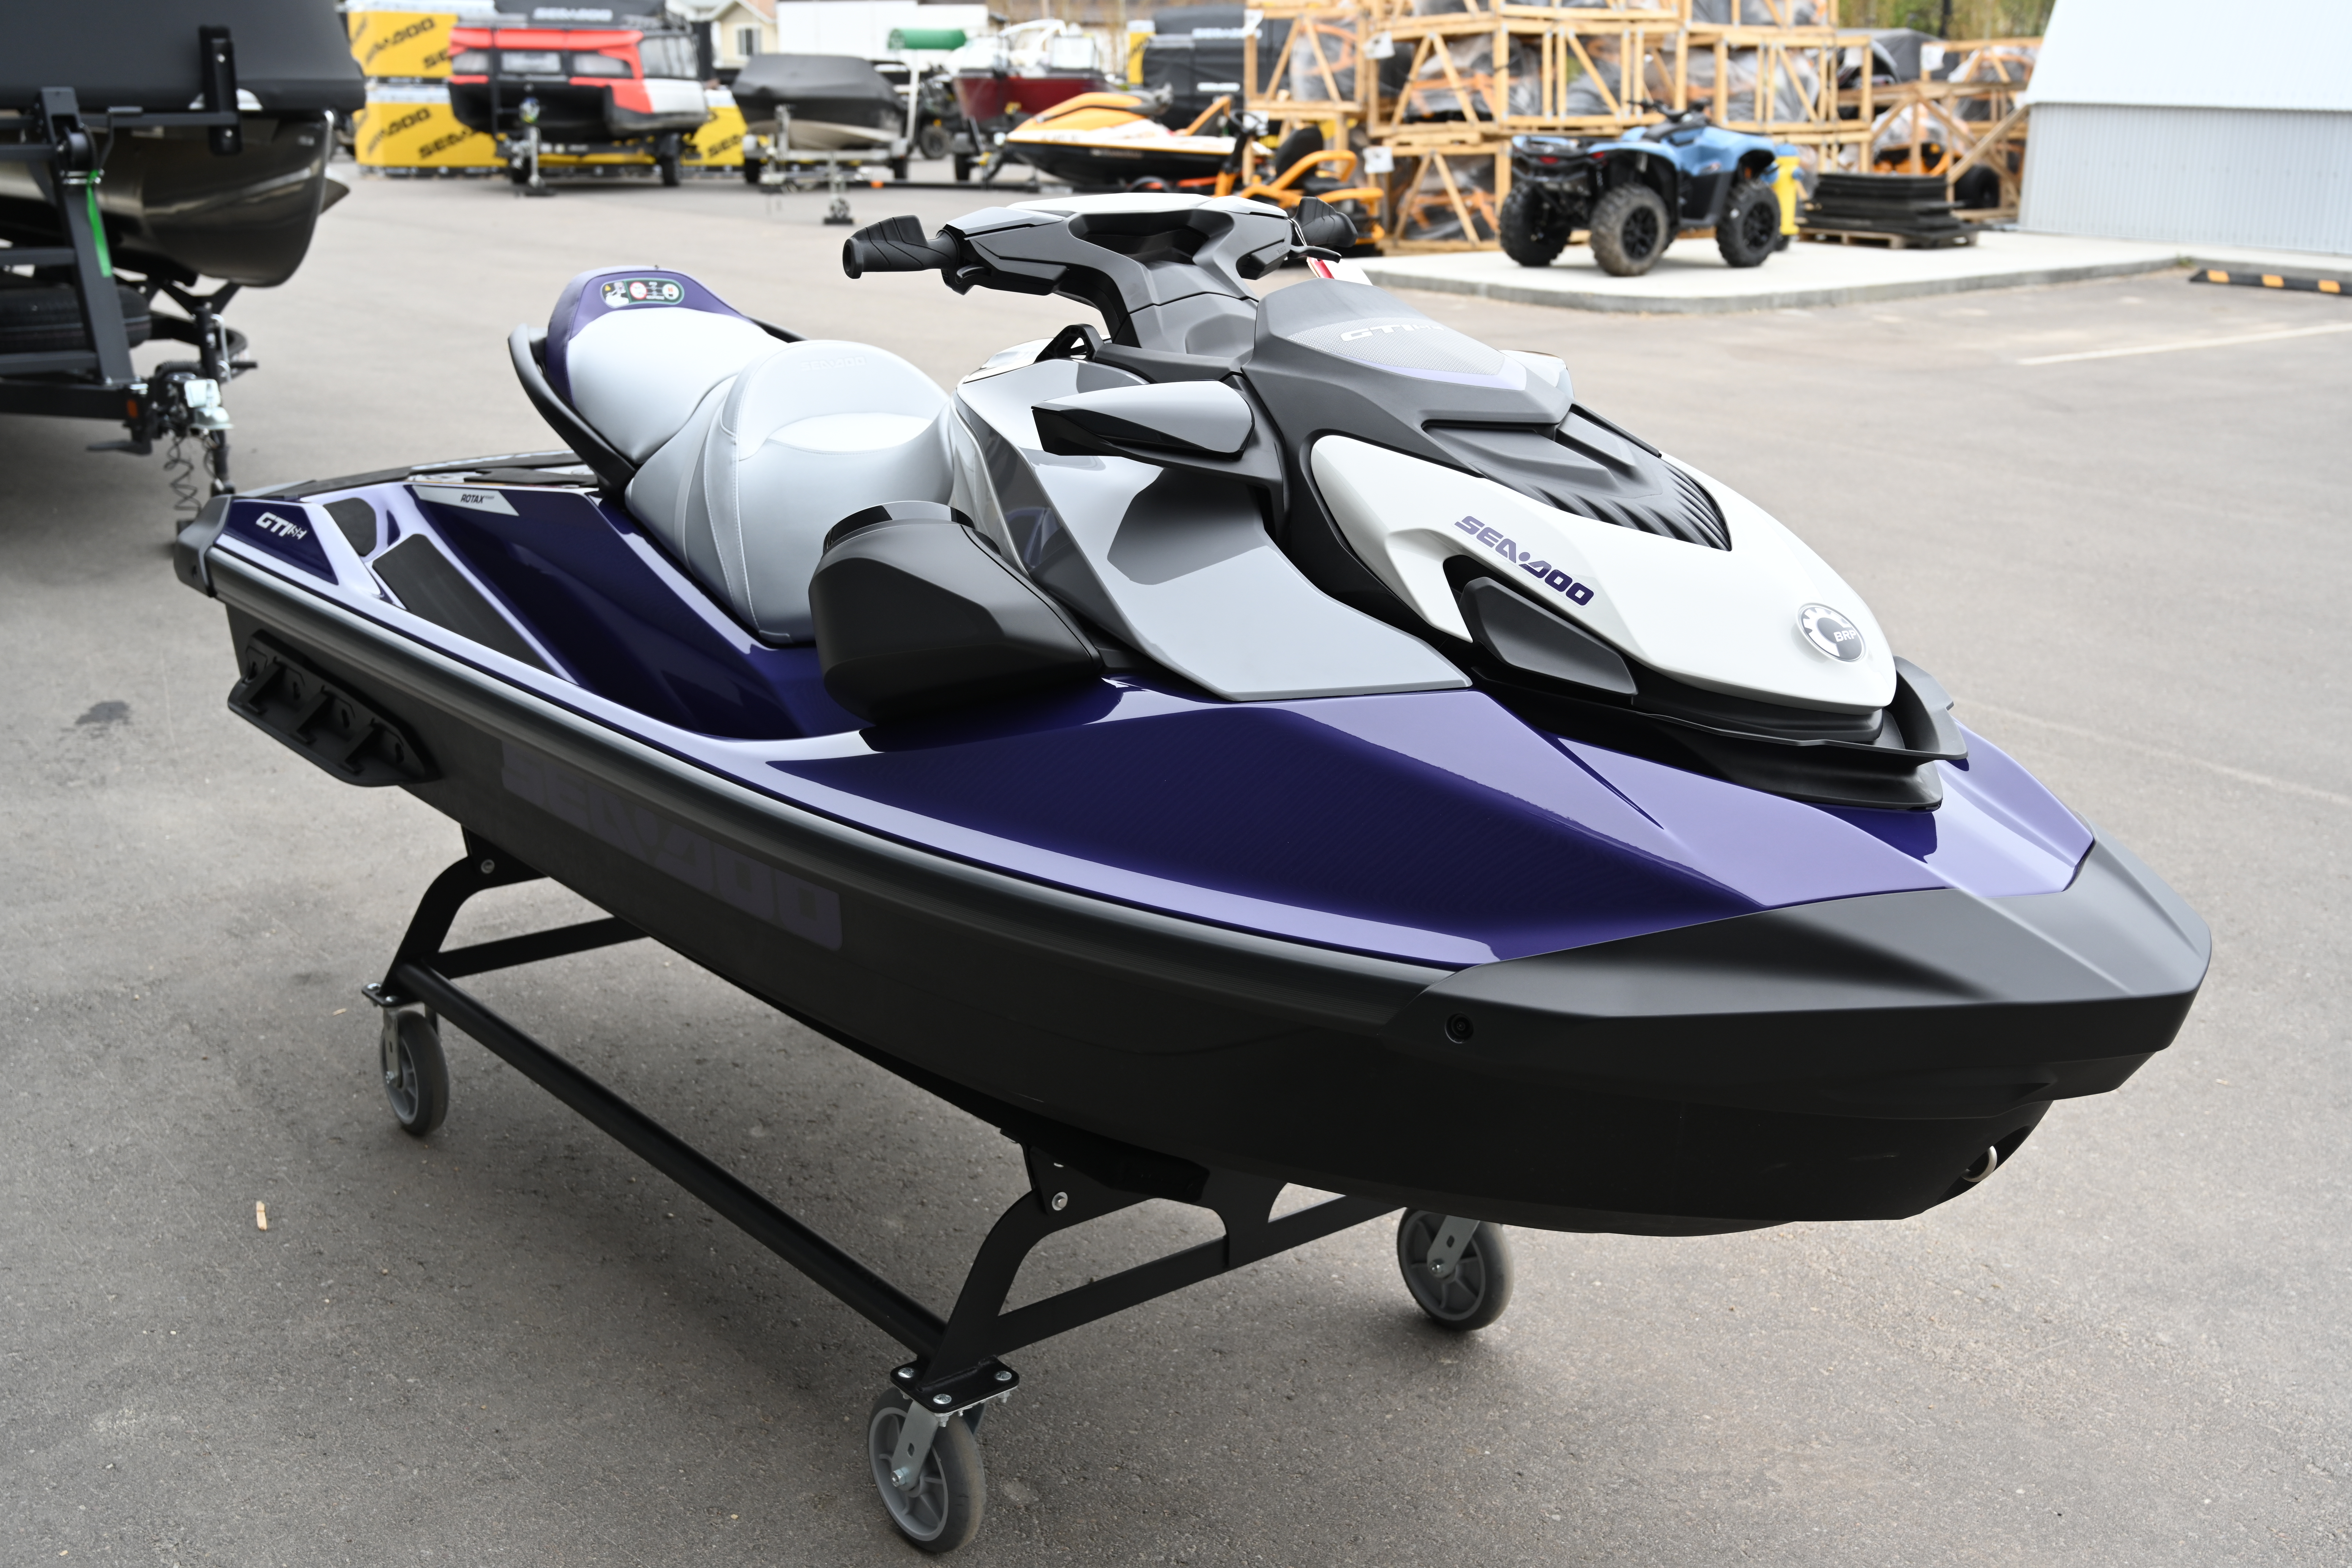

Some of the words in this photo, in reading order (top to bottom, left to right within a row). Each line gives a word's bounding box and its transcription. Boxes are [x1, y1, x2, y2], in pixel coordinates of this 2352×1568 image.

[1340, 324, 1415, 341] GTI
[460, 494, 485, 504] ROTAX
[255, 511, 294, 537] GTI
[1833, 630, 1857, 642] BRP
